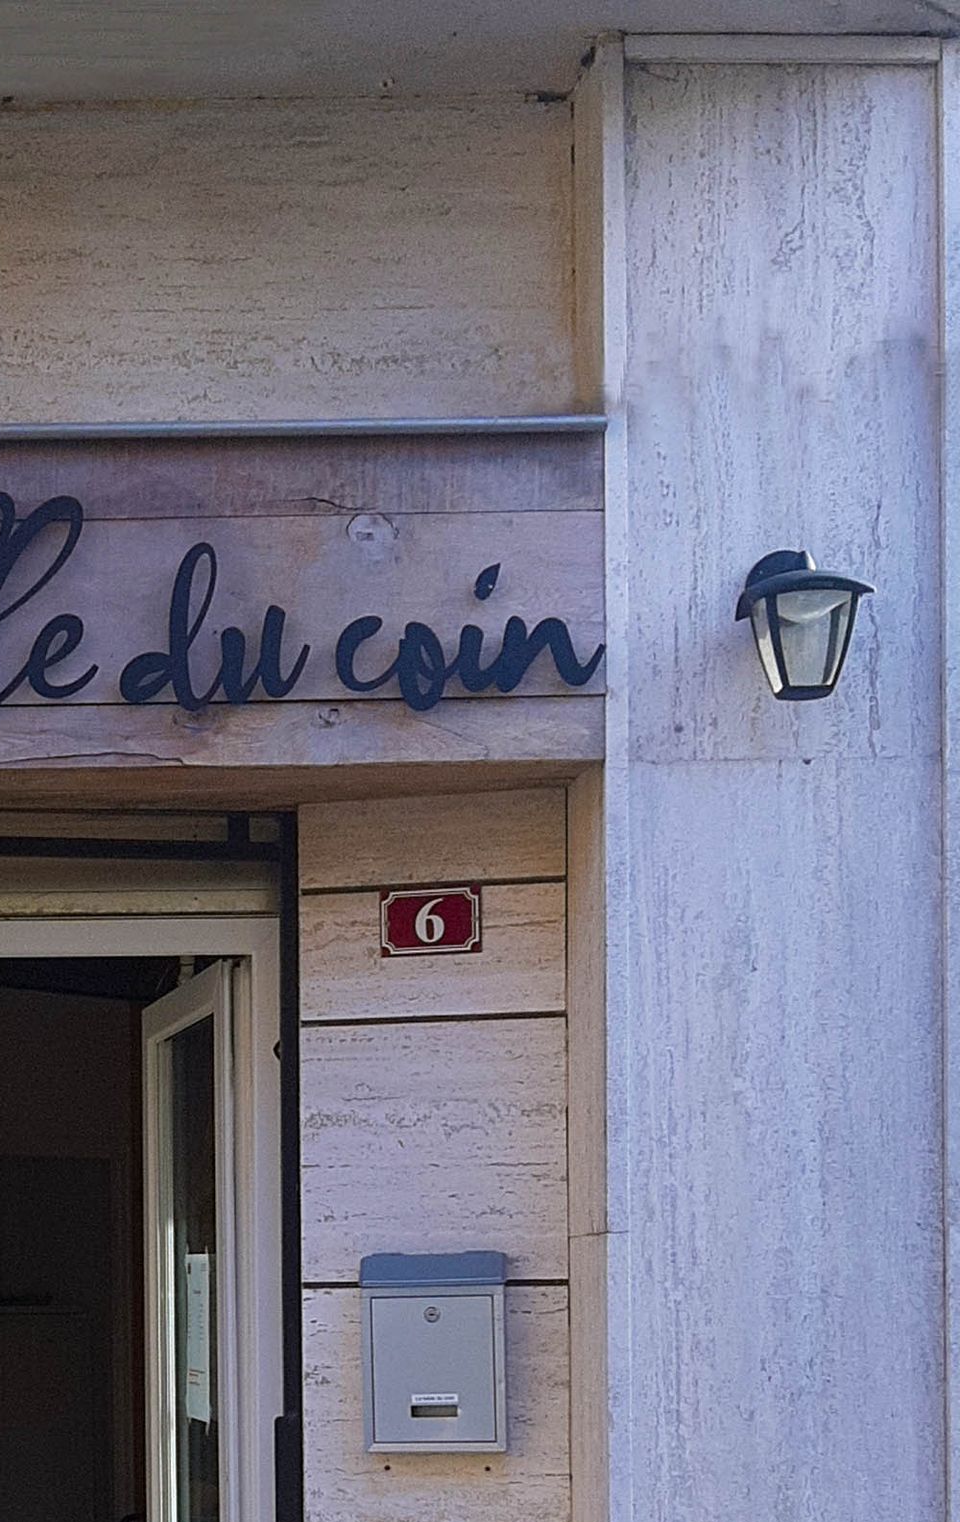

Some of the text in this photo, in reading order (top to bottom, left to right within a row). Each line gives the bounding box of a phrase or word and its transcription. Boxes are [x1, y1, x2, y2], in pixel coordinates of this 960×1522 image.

[120, 542, 310, 711] du
[336, 562, 606, 711] coin
[415, 897, 445, 943] 6
